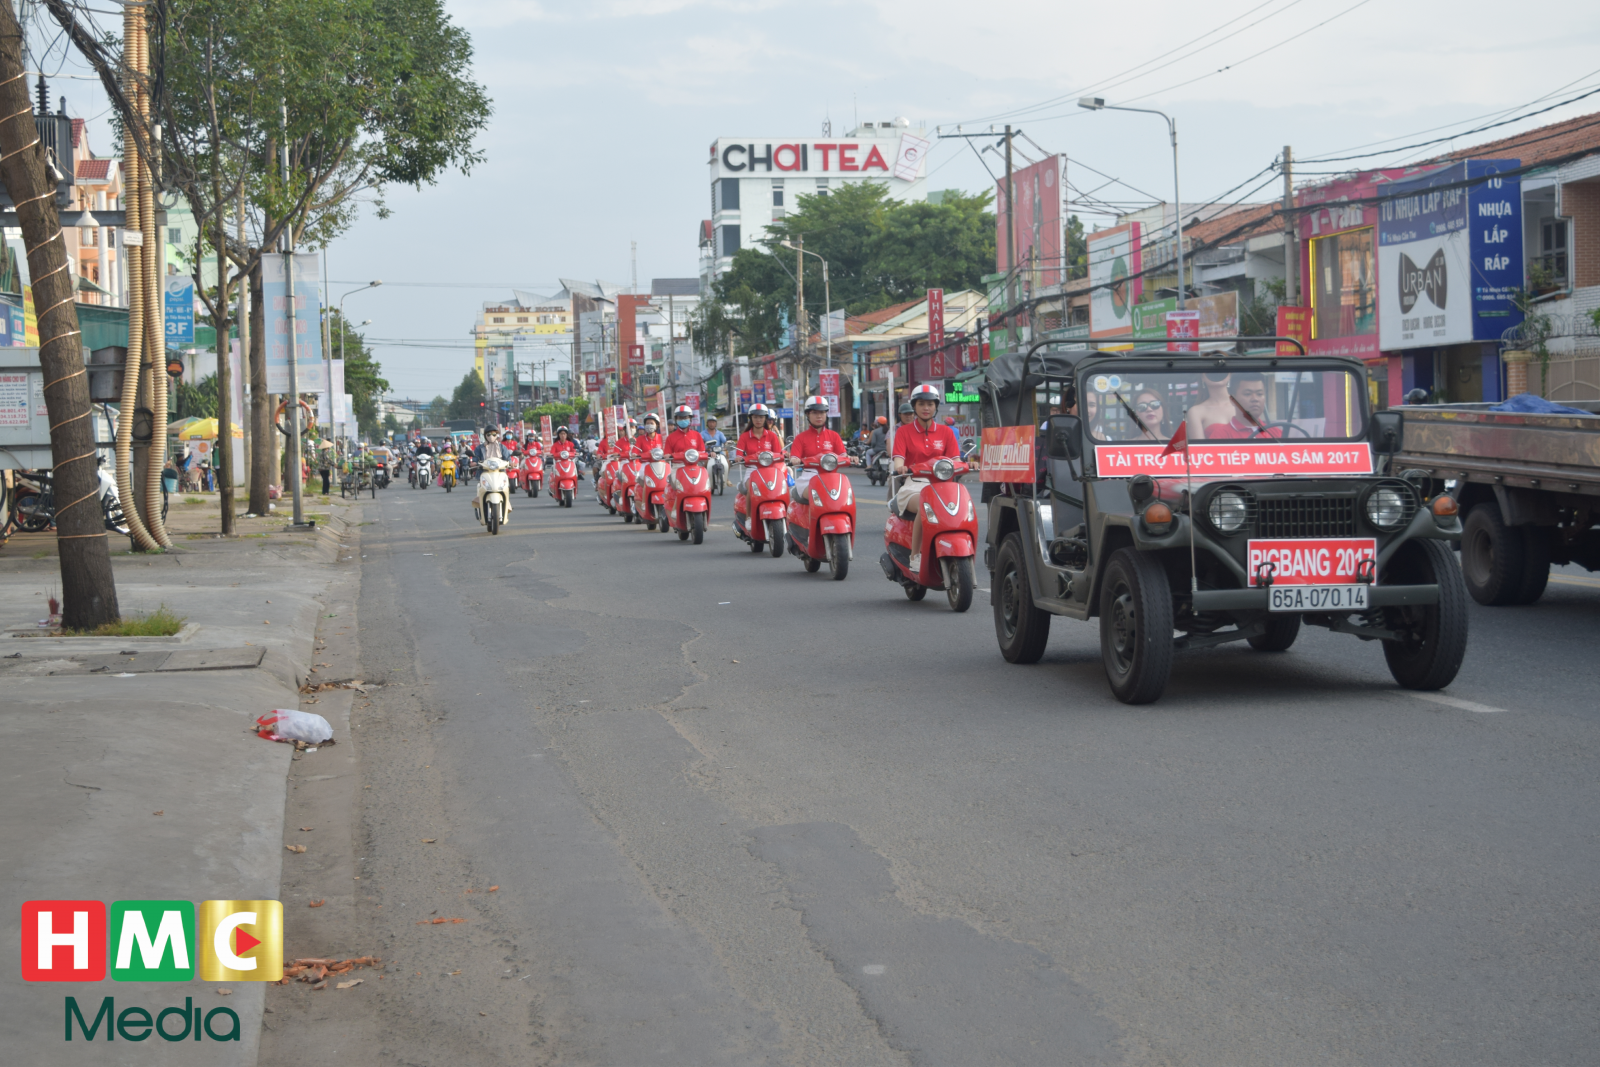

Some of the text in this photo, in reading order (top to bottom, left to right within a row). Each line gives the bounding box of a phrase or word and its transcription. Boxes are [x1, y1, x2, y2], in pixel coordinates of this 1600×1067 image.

[814, 144, 889, 172] TEA
[1478, 200, 1512, 218] NHỰA
[1484, 224, 1508, 244] LẮP
[1484, 254, 1510, 271] RÁP
[166, 322, 188, 335] 3F
[956, 424, 975, 438] ƯỢU
[982, 443, 1030, 470] NguyenKim
[1106, 450, 1359, 470] TÀI TRỢ TRỰC TIẾP MUA SẮM 2017
[1250, 548, 1374, 576] BIGBANG 2017
[1273, 588, 1364, 608] 65A-070.14
